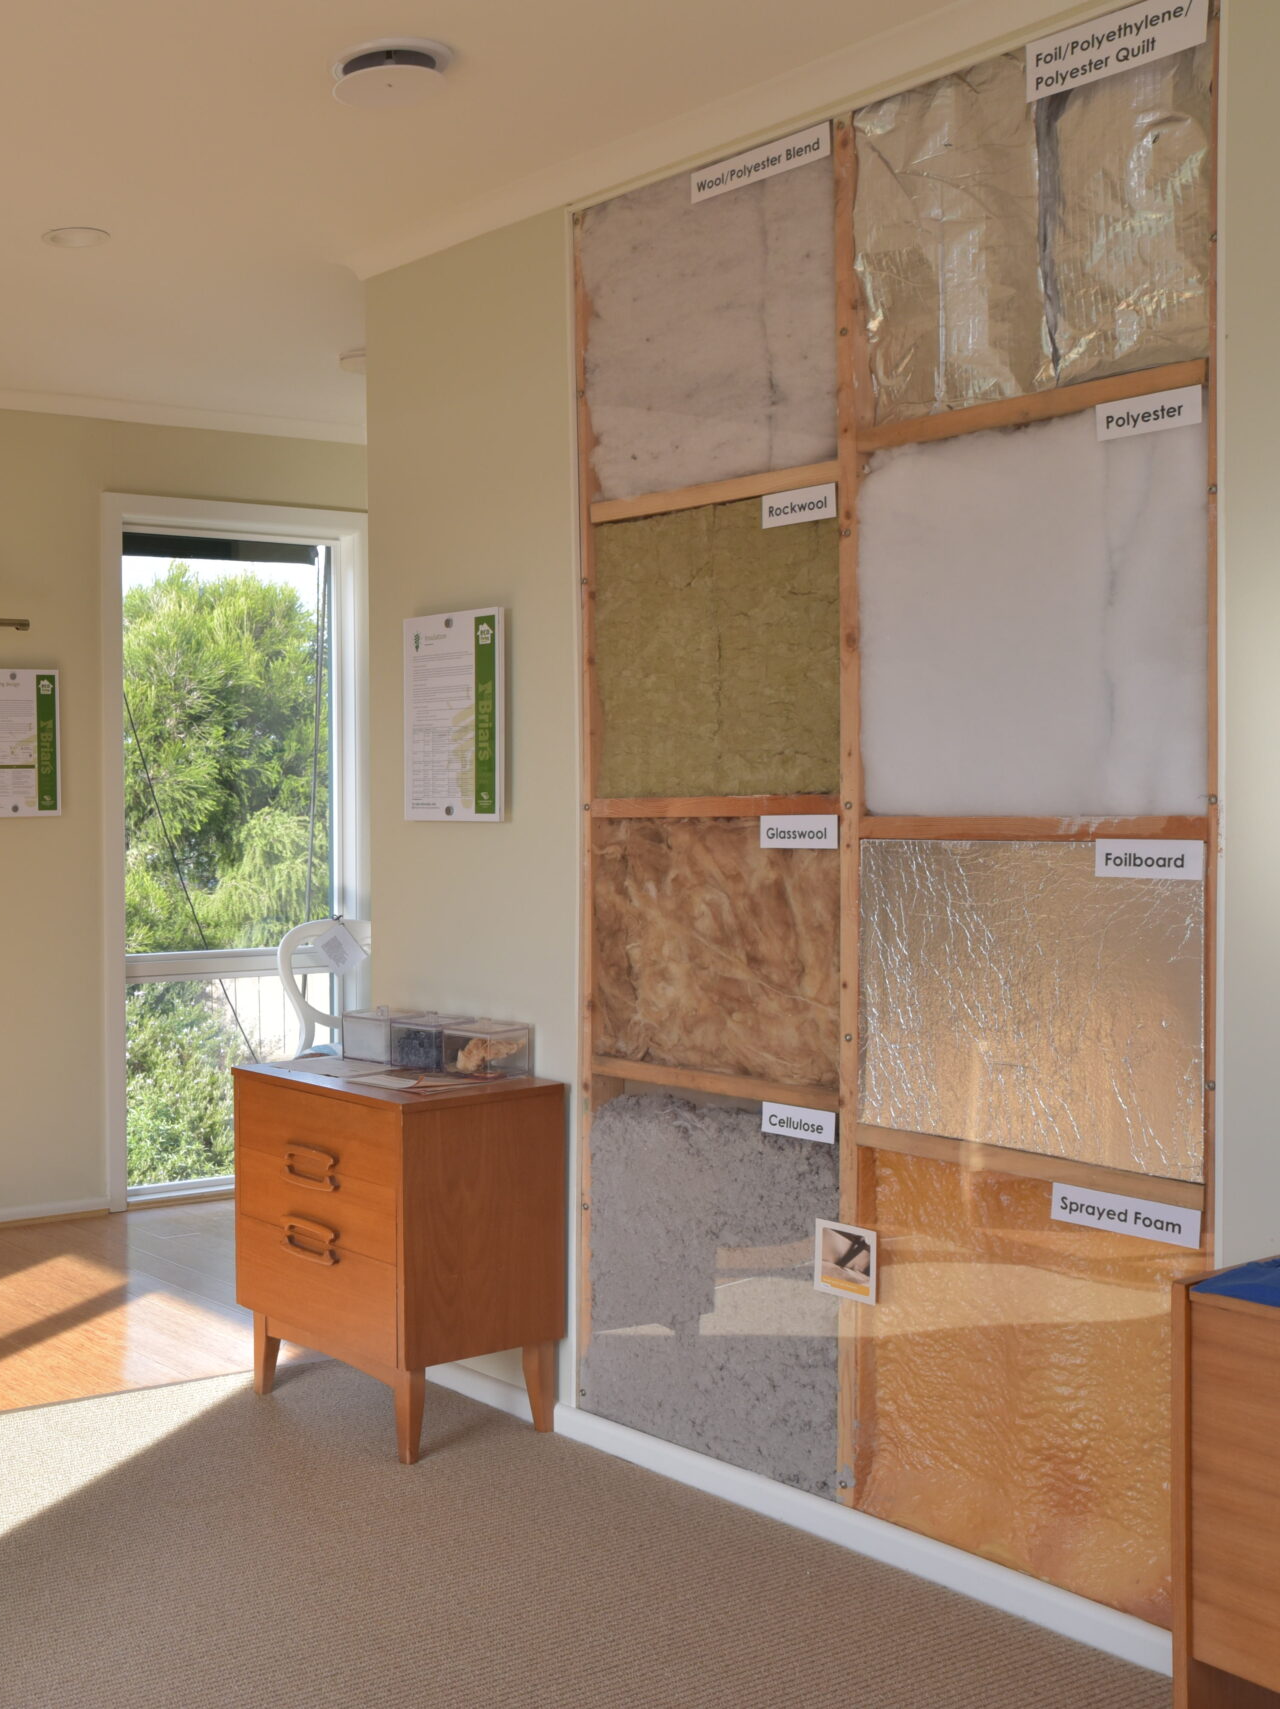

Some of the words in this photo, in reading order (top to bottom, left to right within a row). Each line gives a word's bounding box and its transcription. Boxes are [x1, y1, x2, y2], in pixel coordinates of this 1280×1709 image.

[1035, 0, 1193, 68] Foil/Polyethylene/
[1035, 55, 1111, 91] Polyester
[1115, 37, 1157, 63] Quilt
[696, 153, 783, 193] Wool/Polyester
[785, 137, 821, 161] Blend
[1105, 402, 1184, 431] Polyester
[767, 495, 828, 519] Rockwool
[766, 825, 827, 841] Glasswool
[1104, 852, 1185, 869] Foilboard
[768, 1113, 824, 1134] Cellulose
[1059, 1195, 1128, 1223] Sprayed
[1133, 1211, 1182, 1235] Foam
